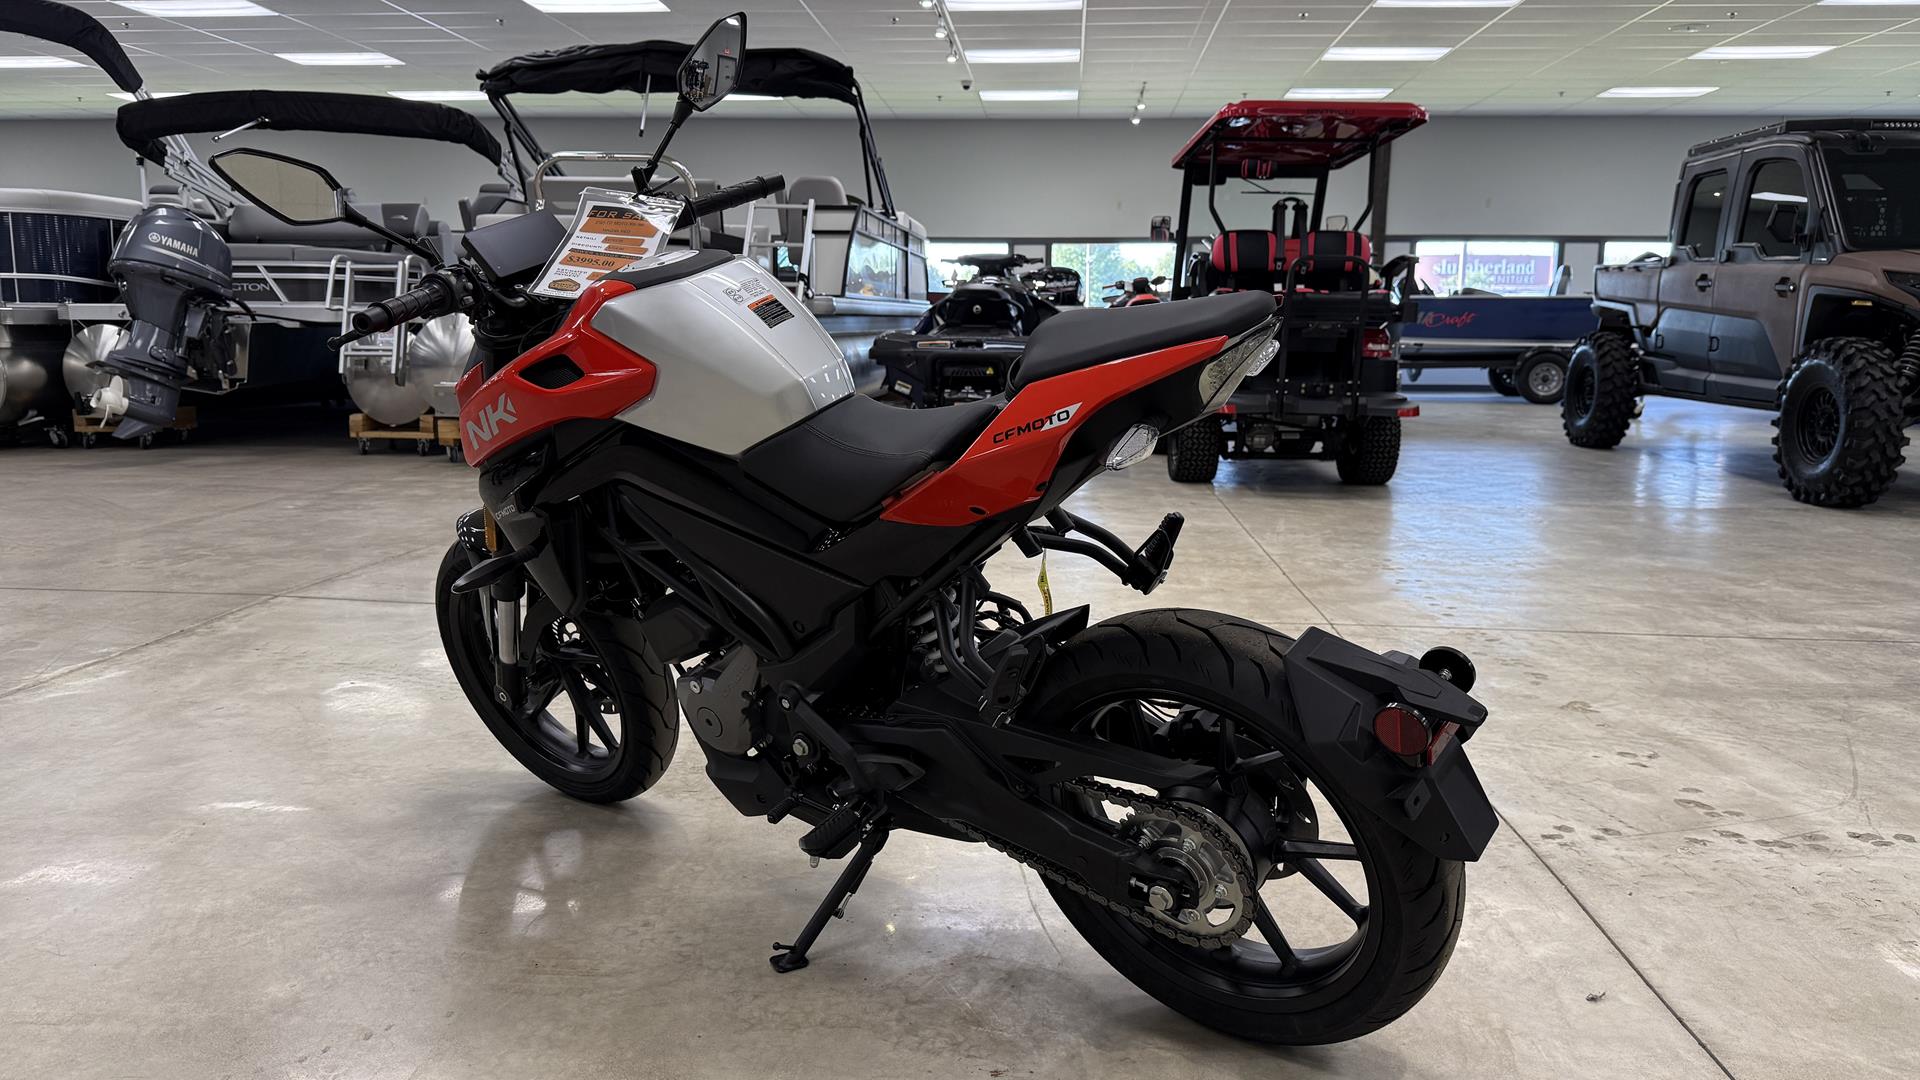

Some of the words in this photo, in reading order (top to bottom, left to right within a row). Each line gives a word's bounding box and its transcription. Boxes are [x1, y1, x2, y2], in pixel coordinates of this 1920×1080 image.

[589, 210, 618, 218] FOR
[622, 212, 643, 220] SA
[161, 235, 199, 257] YAMAHA
[567, 256, 616, 267] $3995.00
[466, 393, 518, 450] NK
[993, 409, 1070, 444] CFMOTO
